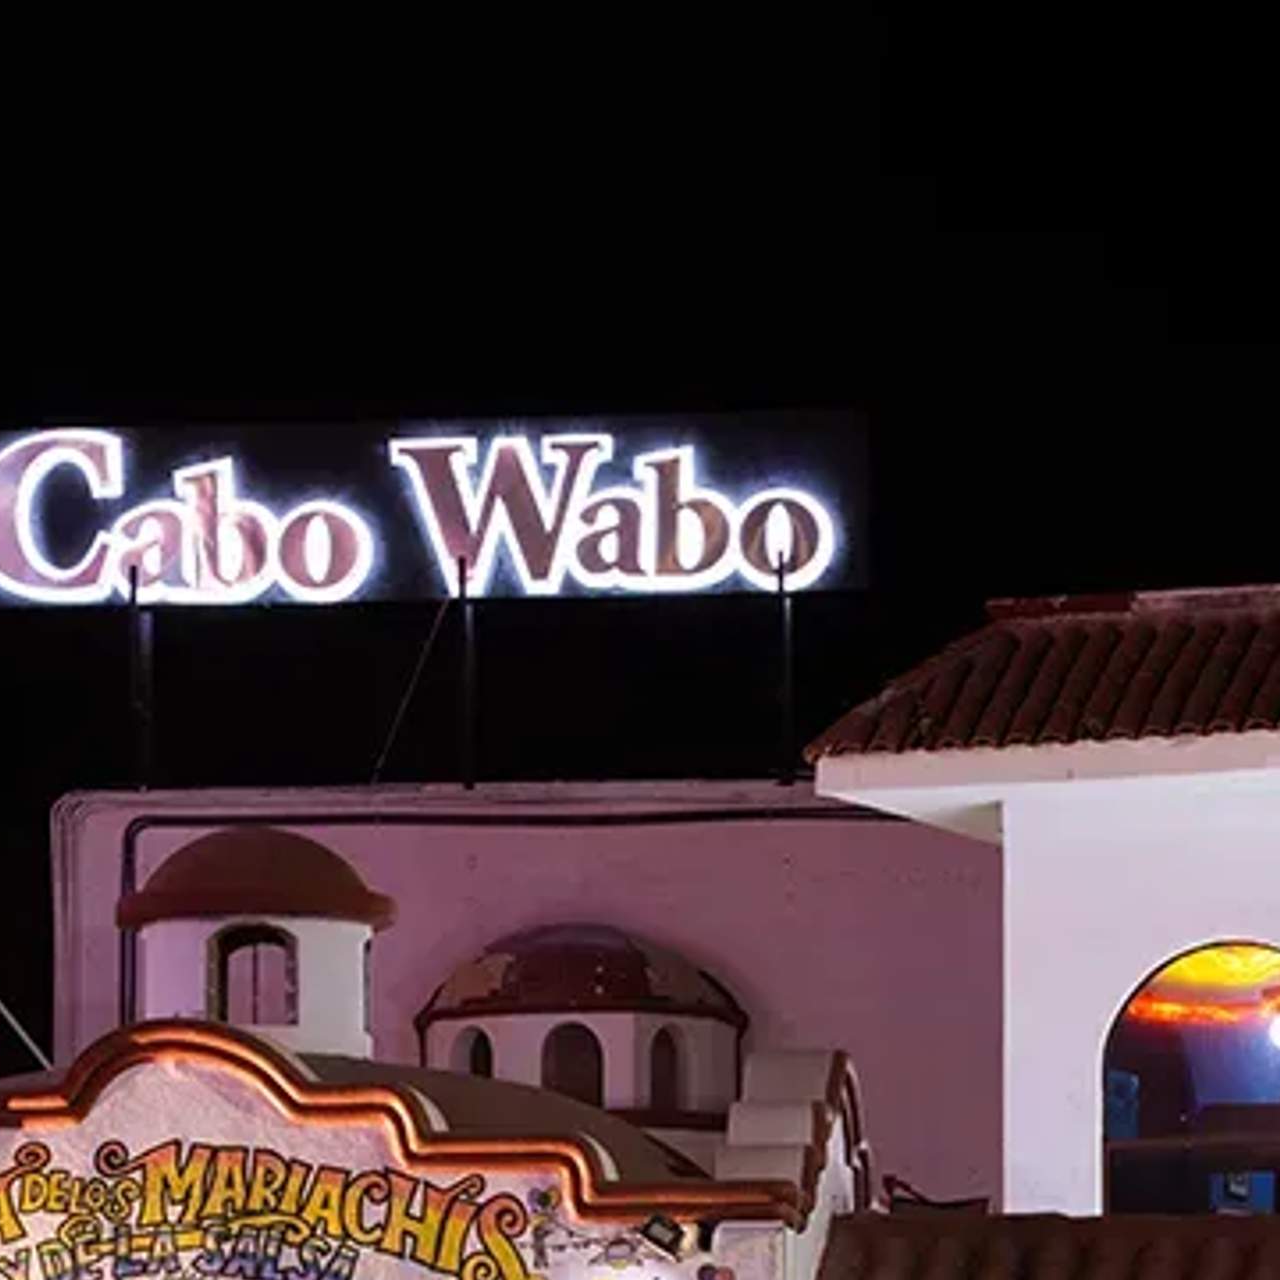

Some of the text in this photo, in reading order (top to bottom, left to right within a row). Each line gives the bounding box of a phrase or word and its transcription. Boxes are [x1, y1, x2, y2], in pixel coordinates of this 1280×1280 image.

[389, 432, 836, 596] Wabo
[20, 1170, 70, 1214] DE
[71, 1176, 142, 1223] LOS
[112, 1224, 181, 1279] LA
